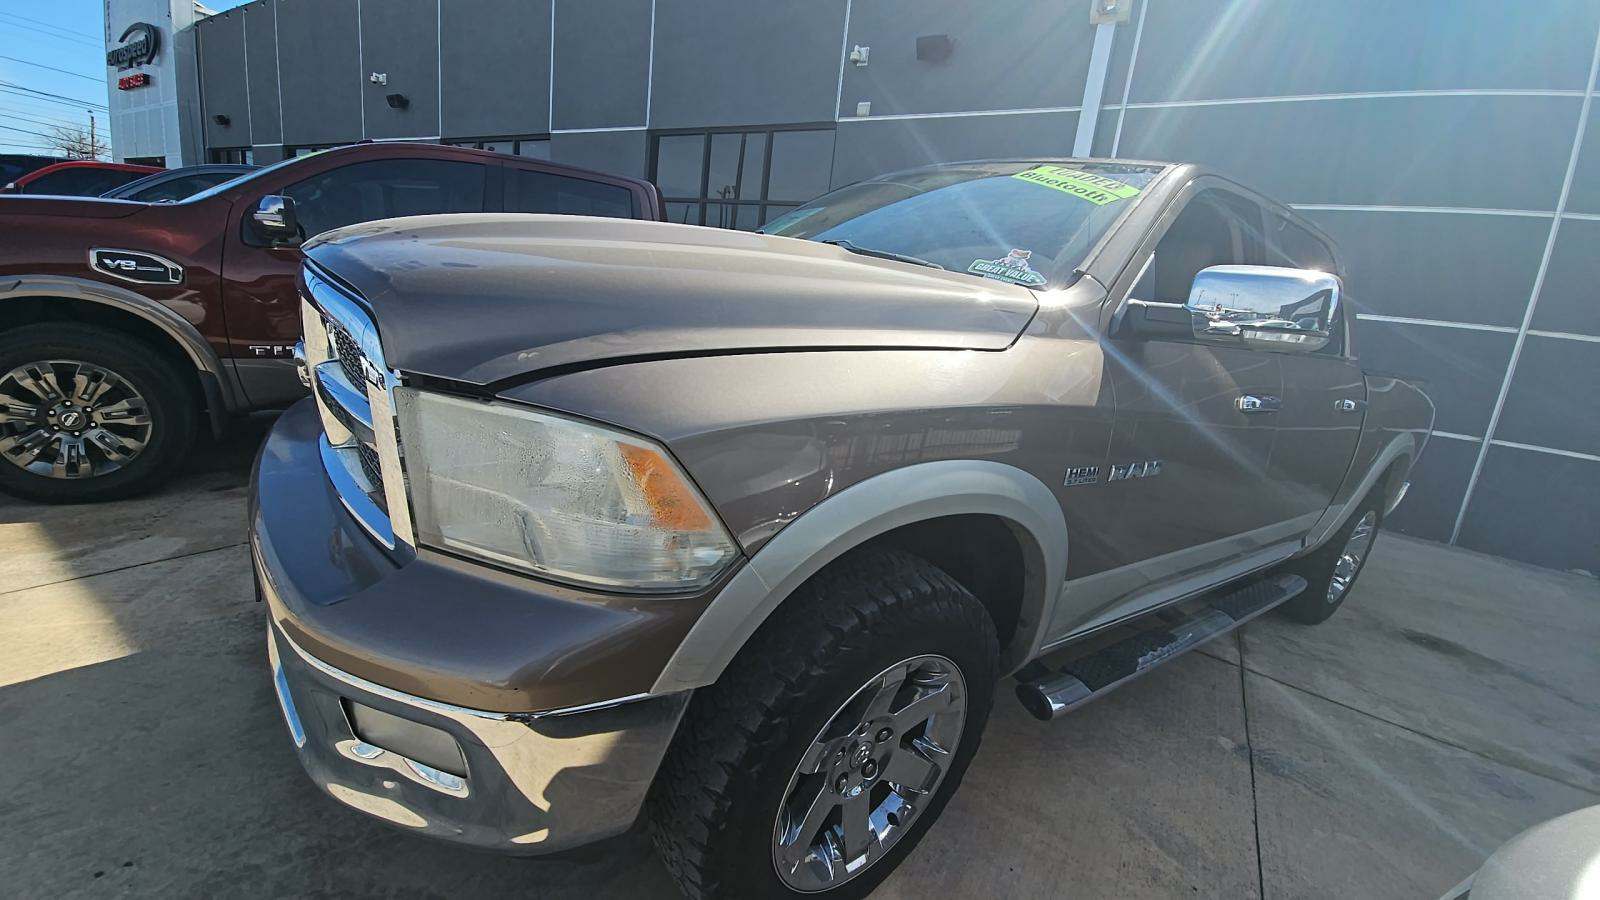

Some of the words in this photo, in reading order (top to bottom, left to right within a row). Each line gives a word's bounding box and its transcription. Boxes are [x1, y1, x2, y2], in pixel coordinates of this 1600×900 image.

[1020, 171, 1108, 202] Bluetooth
[102, 258, 136, 270] V8
[974, 263, 1004, 275] GREAT
[1005, 269, 1036, 283] VALUE
[1064, 467, 1099, 478] HEMI
[1108, 460, 1161, 481] RAM
